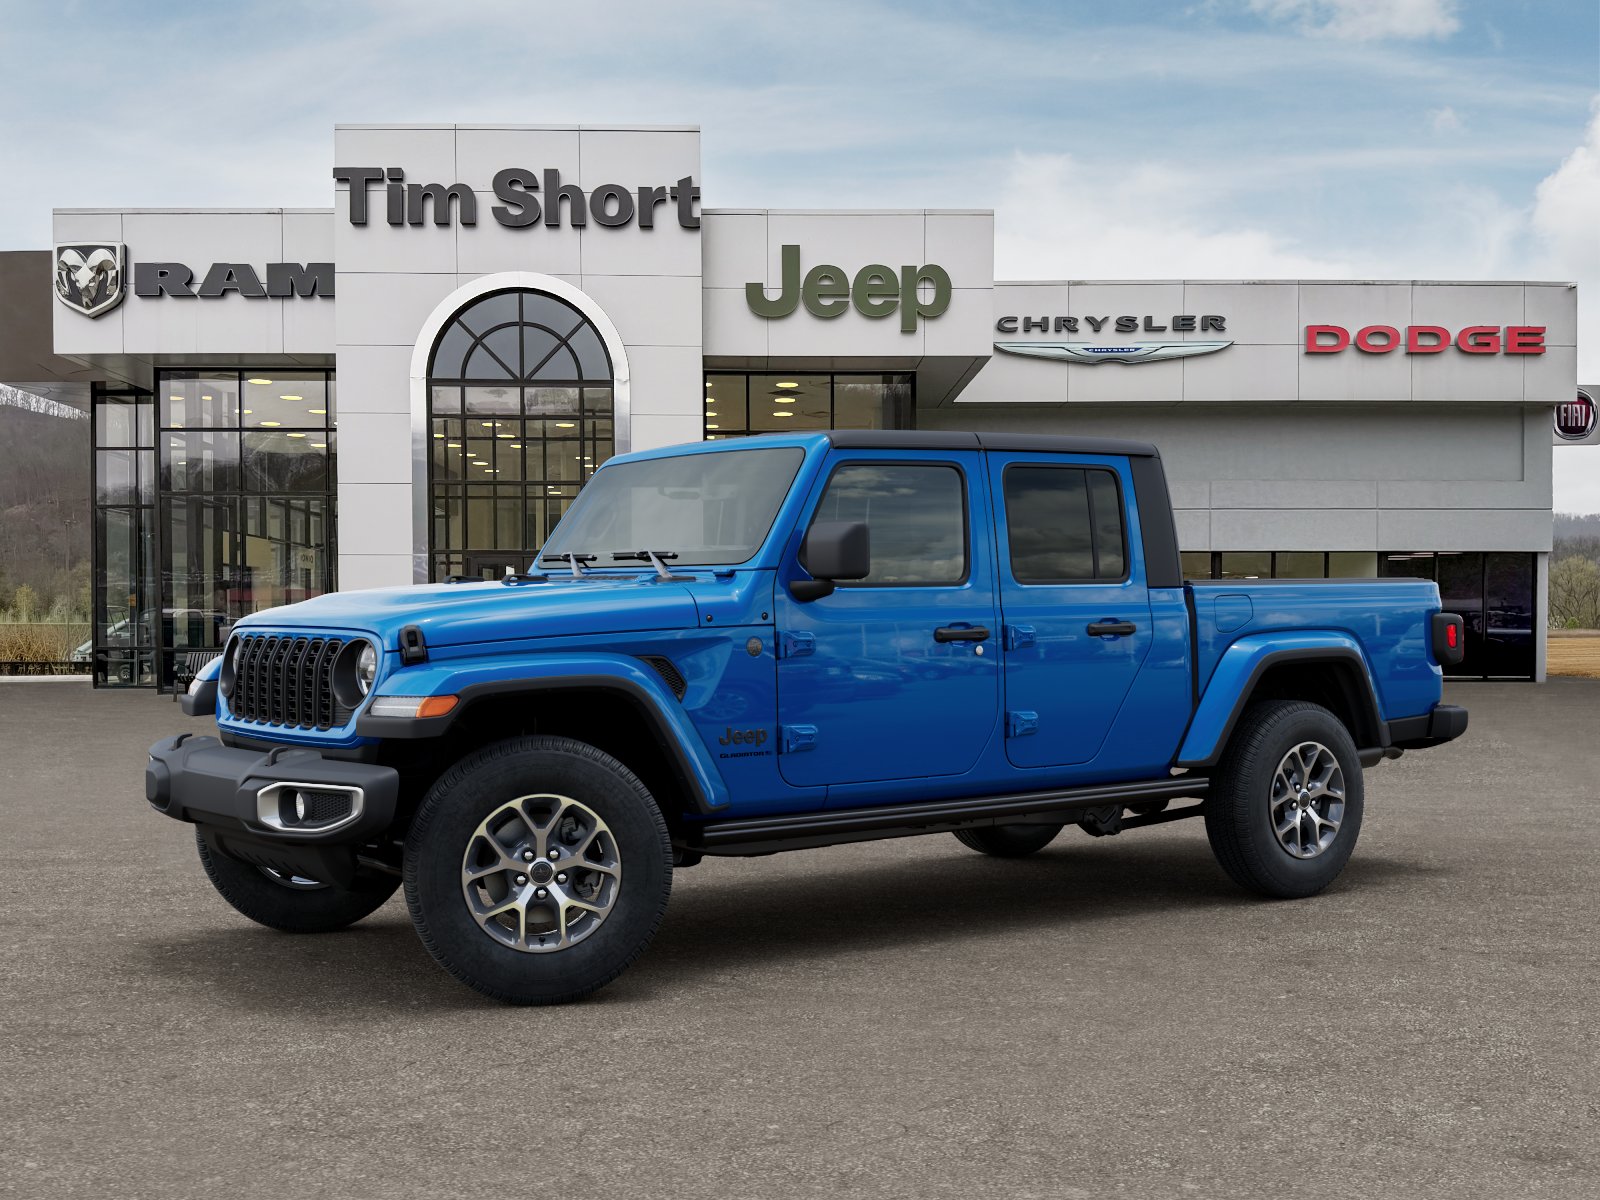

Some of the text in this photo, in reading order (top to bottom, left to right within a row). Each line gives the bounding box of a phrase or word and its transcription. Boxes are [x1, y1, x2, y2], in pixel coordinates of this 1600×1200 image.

[333, 167, 700, 229] Tim Short
[134, 262, 335, 299] RAM
[745, 244, 953, 333] Jeep
[997, 315, 1227, 333] CHRYSLER
[1304, 325, 1546, 355] DODGE
[1560, 404, 1586, 427] FIAT
[719, 727, 768, 747] Jeep
